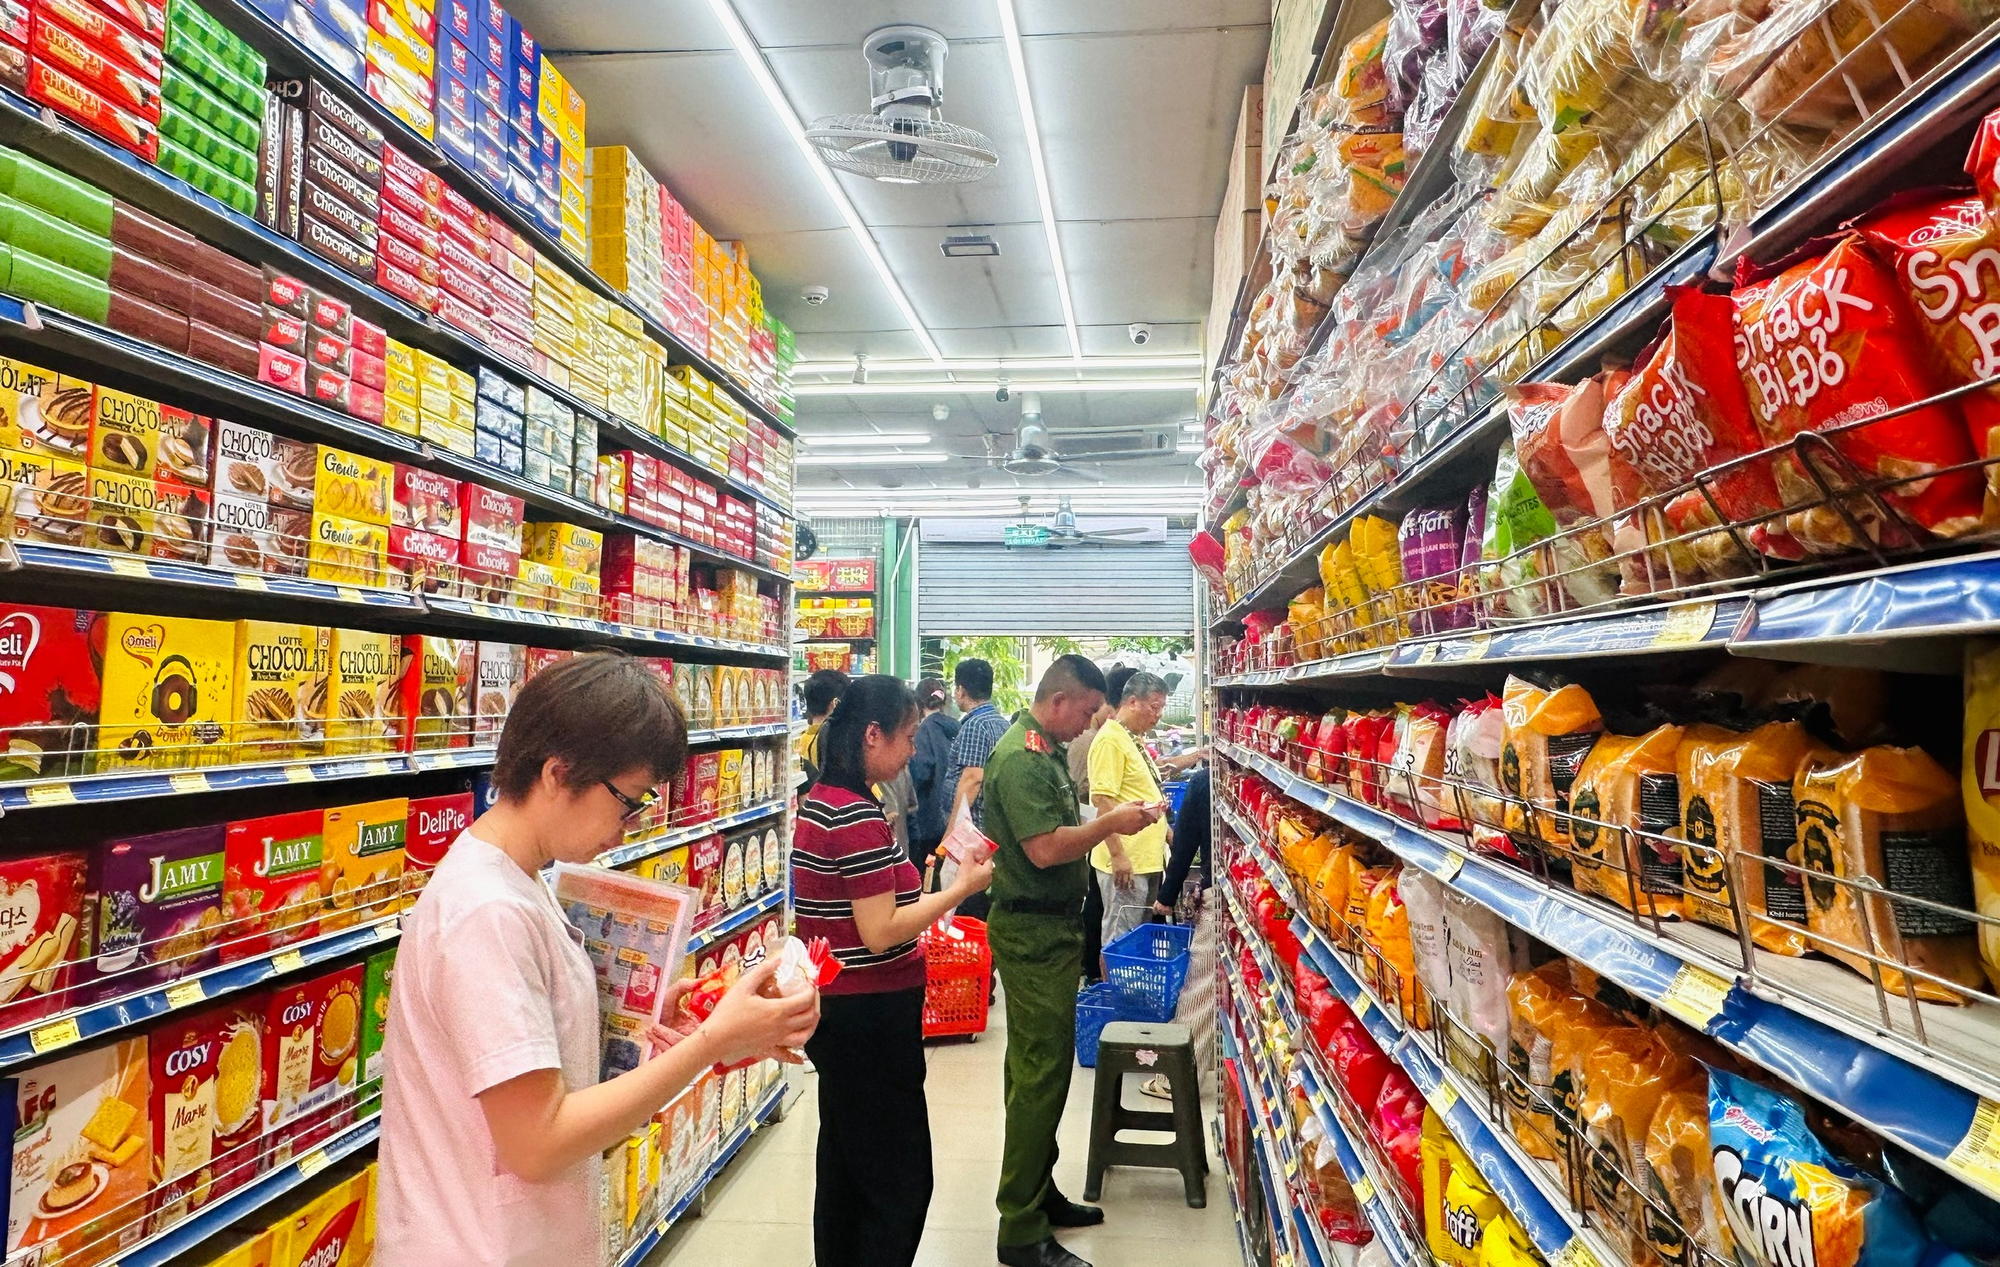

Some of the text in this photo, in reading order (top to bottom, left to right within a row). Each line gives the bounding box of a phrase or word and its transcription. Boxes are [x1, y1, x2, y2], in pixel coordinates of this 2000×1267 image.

[452, 3, 468, 20] Tipo
[409, 37, 429, 61] Tipo
[451, 40, 466, 60] Tipo
[488, 36, 502, 55] Tipo
[521, 31, 533, 51] Tipo
[486, 72, 500, 92] Tipo
[519, 66, 531, 84] Tipo
[542, 63, 557, 84] Tipo
[42, 68, 101, 111] CHOCOLAT
[450, 80, 465, 98] Tipo
[319, 90, 366, 135] ChocoPie
[486, 110, 499, 128] Tipo
[519, 104, 531, 121] Tipo
[450, 119, 464, 137] Tipo
[542, 129, 554, 147] Tipo
[319, 124, 365, 167] ChocoPie
[316, 158, 362, 201] ChocoPie
[392, 153, 424, 183] ChocoPie
[542, 164, 553, 181] Tipo
[313, 189, 360, 230] ChocoPie
[311, 223, 359, 262] ChocoPie
[388, 239, 420, 267] ChocoPie
[272, 281, 295, 300] nabati
[386, 268, 419, 294] ChocoPie
[318, 303, 338, 321] nabati
[317, 341, 338, 359] nabati
[270, 359, 292, 375] nabati
[317, 378, 338, 395] nabati
[1751, 349, 1790, 422] Bí
[101, 397, 185, 438] CHOCOLAT
[94, 478, 182, 514] CHOCOLAT
[405, 471, 450, 498] ChocoPie
[481, 495, 514, 517] ChocoPie
[403, 533, 448, 560] ChocoPie
[571, 530, 596, 550] Custas
[477, 551, 510, 572] ChocoPie
[127, 635, 157, 649] Omeli
[278, 635, 303, 647] LOTTE
[361, 643, 380, 652] LOTTE
[249, 644, 329, 673] CHOCOLAT
[339, 651, 399, 676] CHOCOLAT
[419, 808, 466, 836] DeliPie
[349, 820, 399, 855] JAMY
[253, 836, 312, 876] JAMY
[139, 855, 212, 904] JAMY
[282, 1001, 314, 1026] COSY
[165, 1041, 212, 1078] COSY
[171, 1102, 208, 1131] Marie
